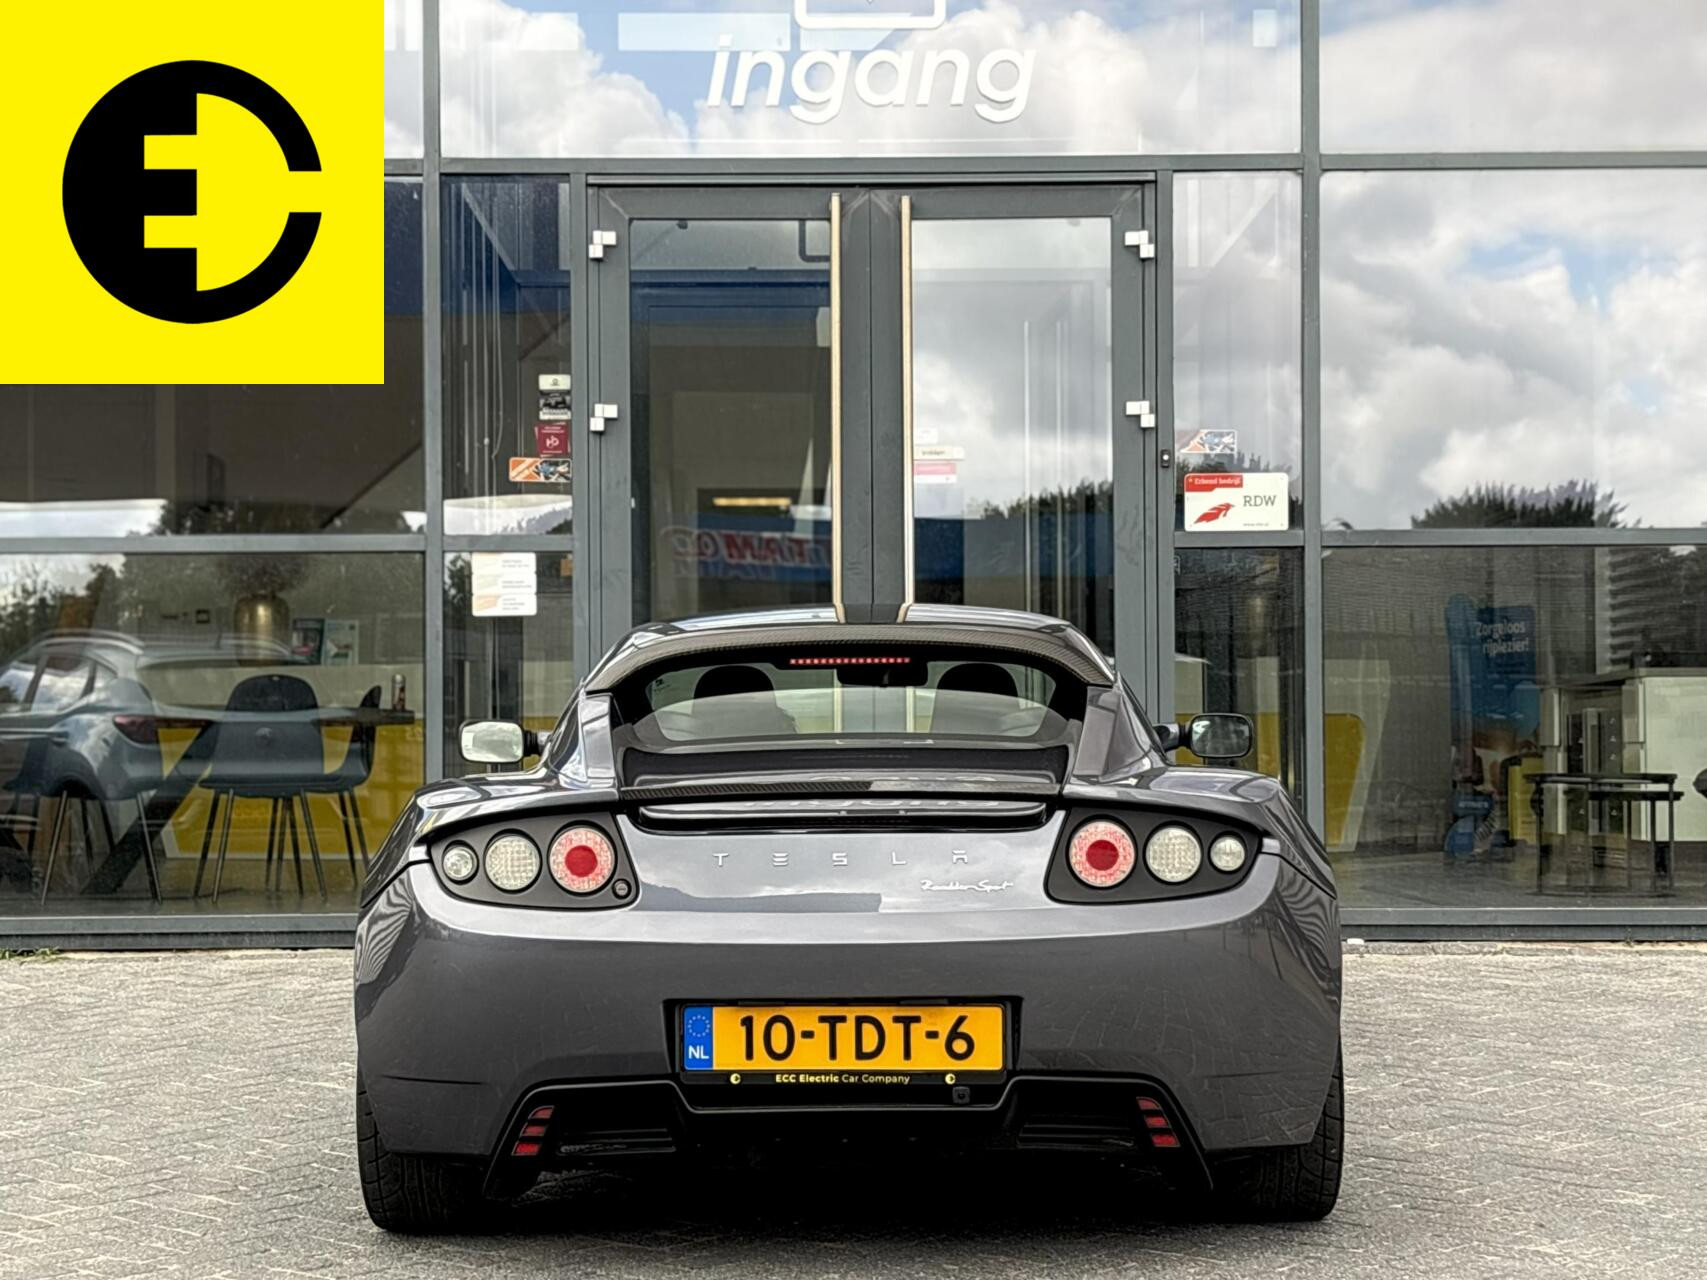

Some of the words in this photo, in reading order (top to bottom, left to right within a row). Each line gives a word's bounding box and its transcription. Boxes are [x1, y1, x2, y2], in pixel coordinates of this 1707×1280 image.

[707, 33, 1036, 125] ingang
[1243, 495, 1277, 507] RDW
[739, 1014, 976, 1062] 10-TDT-6
[688, 1046, 709, 1060] NL
[775, 1074, 797, 1083] ECC
[799, 1073, 840, 1083] Electric
[841, 1074, 859, 1083] Car
[861, 1074, 911, 1085] Company
